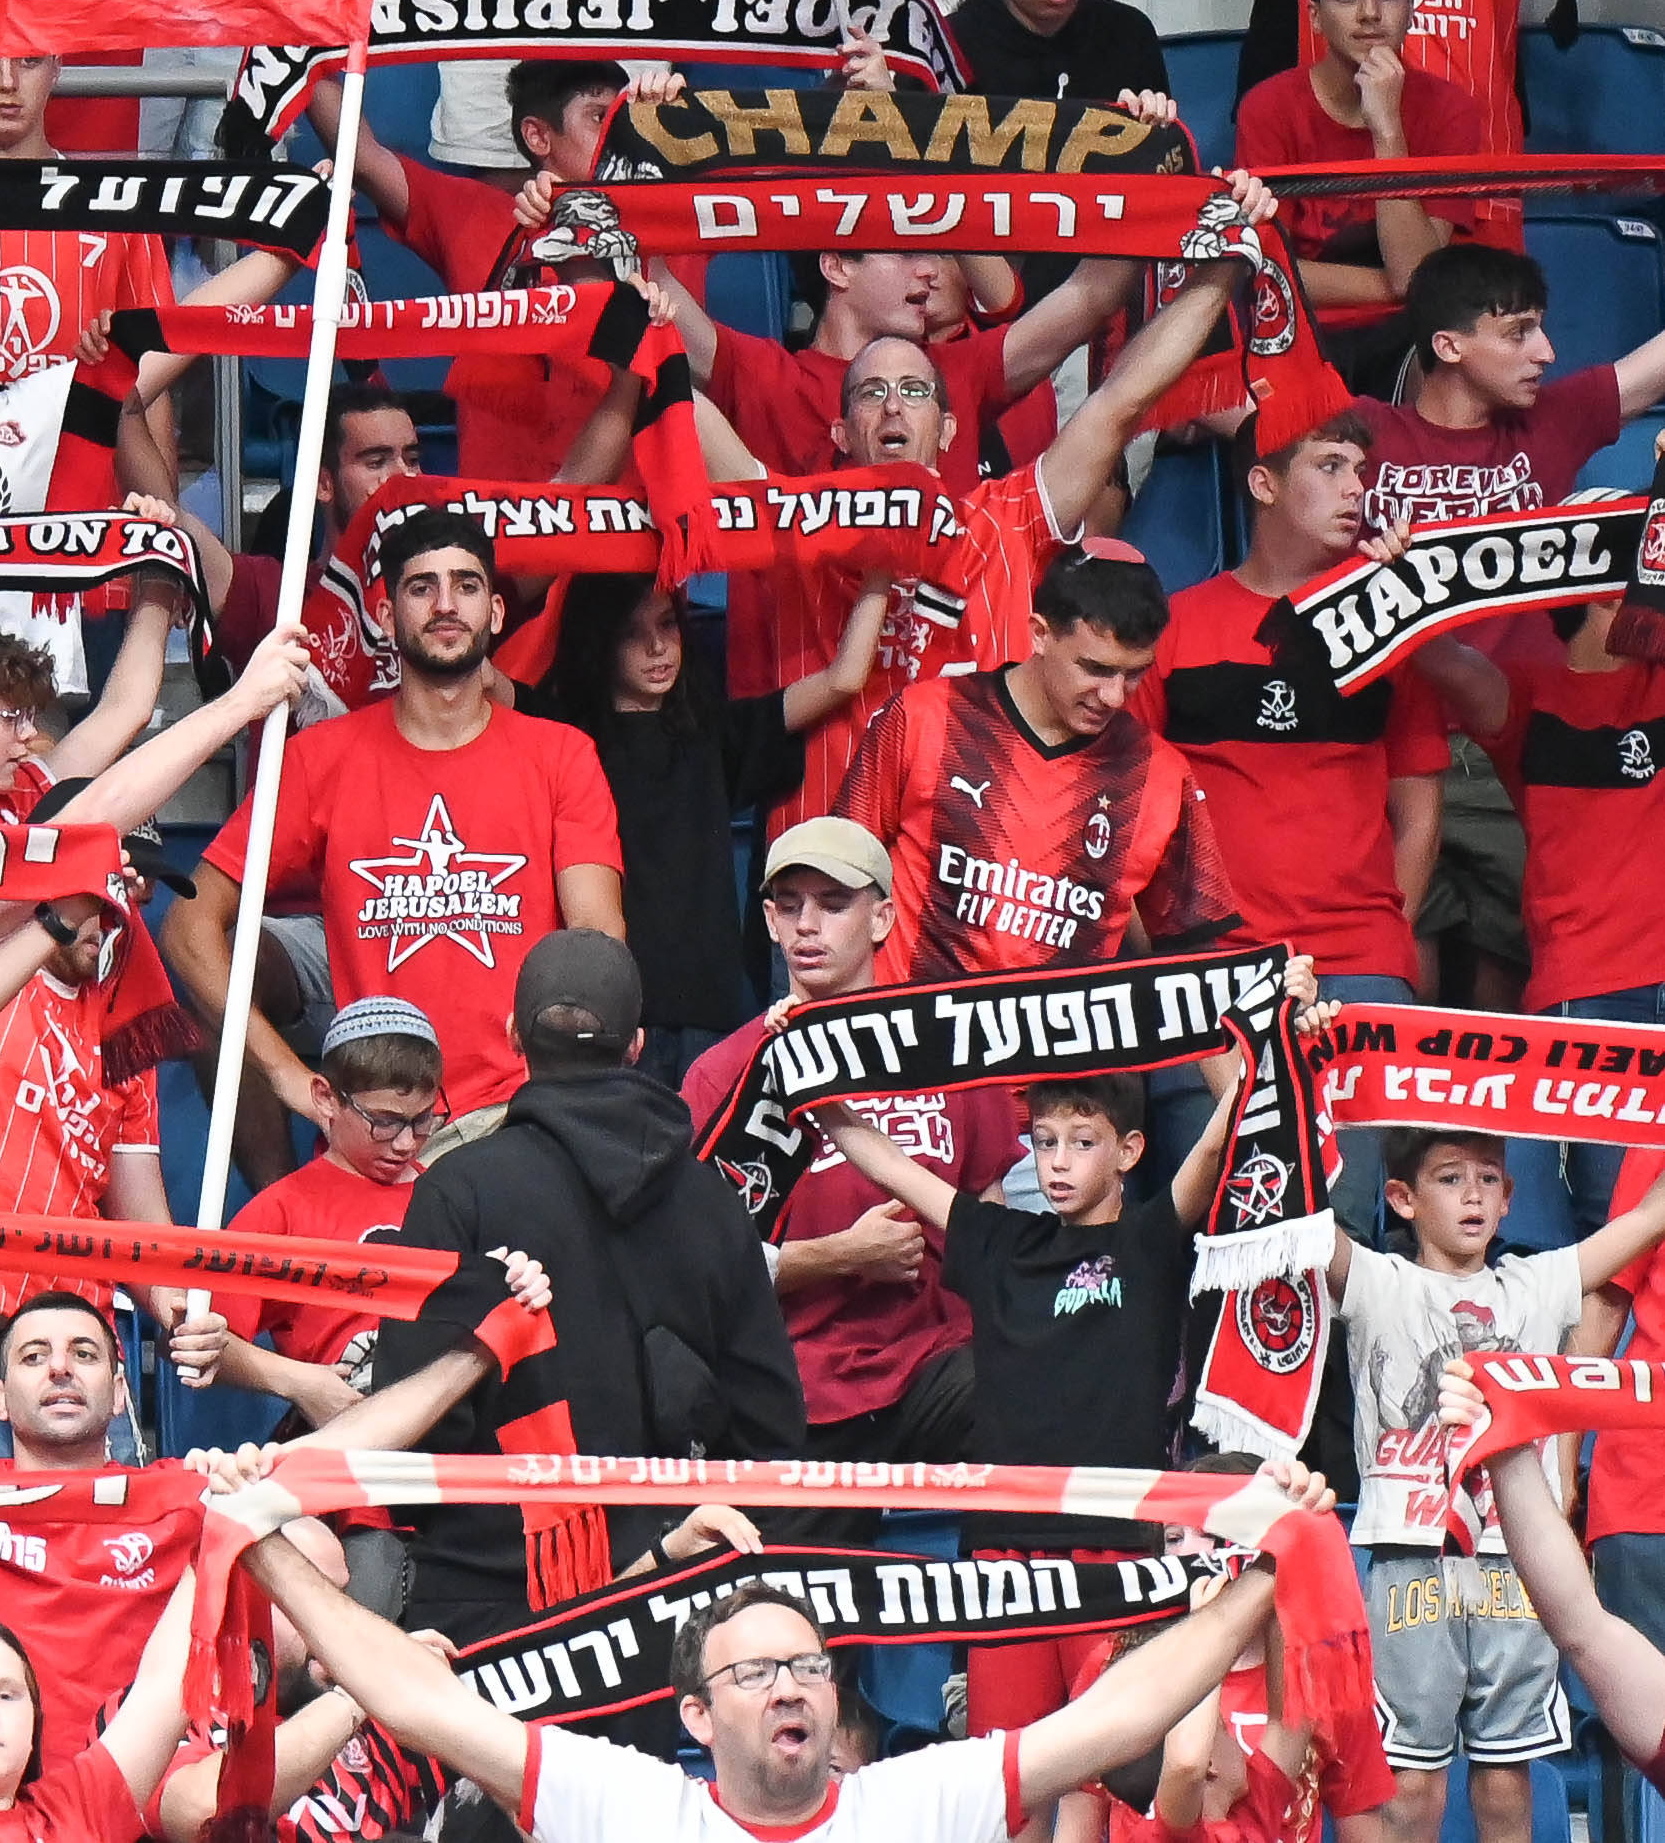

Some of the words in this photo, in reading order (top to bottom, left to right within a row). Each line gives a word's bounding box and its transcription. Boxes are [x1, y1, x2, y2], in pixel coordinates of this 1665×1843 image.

[629, 87, 1152, 173] CHAMP
[37, 162, 326, 228] הפועל
[693, 187, 1126, 240] ירושלים
[32, 518, 109, 553] ON
[766, 487, 922, 536] הפועל
[1311, 522, 1612, 669] HAPOEL
[356, 893, 523, 921] JERUSALEM
[382, 873, 493, 899] HAPOEL
[937, 843, 1105, 921] Emirates
[356, 923, 390, 941] LOVE
[390, 921, 426, 938] WITH
[427, 921, 448, 937] NO
[448, 918, 523, 938] CONDITIONS
[956, 891, 996, 927] FLY
[995, 901, 1078, 950] BETTER
[934, 981, 1140, 1067] הפועל
[1415, 1028, 1529, 1064] CUP
[1383, 1063, 1517, 1110] גביע
[1532, 1077, 1665, 1124] המד
[879, 1557, 1081, 1625] המוות
[1385, 1575, 1441, 1638] LOS
